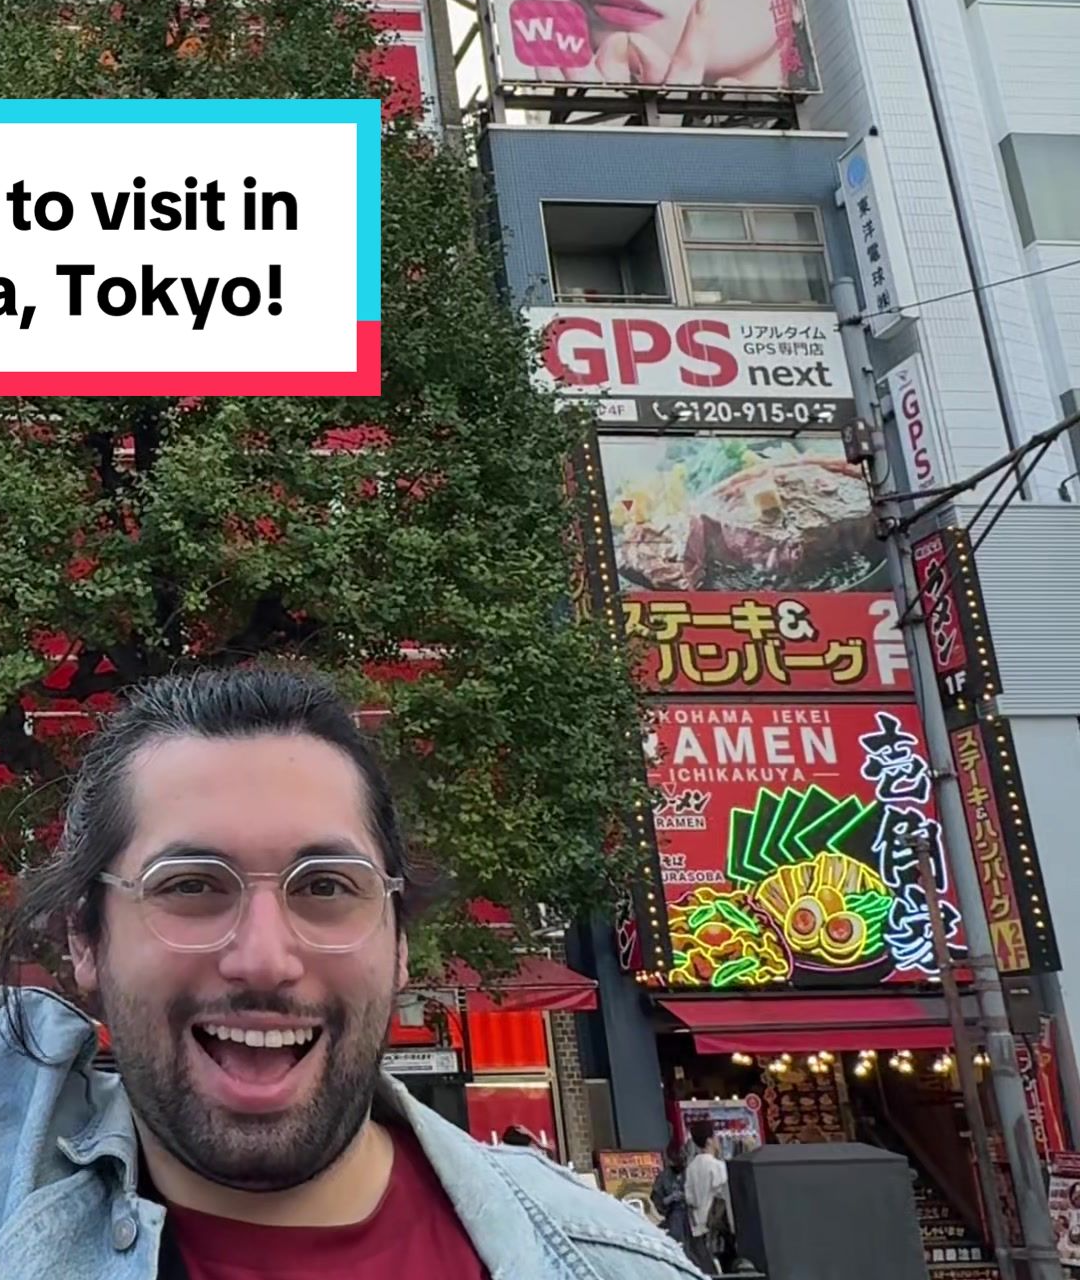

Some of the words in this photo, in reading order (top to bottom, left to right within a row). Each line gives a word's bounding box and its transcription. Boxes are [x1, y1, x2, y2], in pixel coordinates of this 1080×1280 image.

[740, 325, 826, 339] リアルタイム
[541, 316, 739, 387] GPS
[748, 361, 832, 387] next
[901, 389, 932, 481] GPS
[621, 599, 819, 641] ステーキ&
[657, 638, 864, 683] ハンバーグ
[945, 671, 967, 696] 1F
[646, 709, 753, 724] KOHAMA
[773, 710, 830, 724] IEKEI
[669, 768, 806, 782] ICHIKAKUYA
[655, 817, 705, 829] RAMEN
